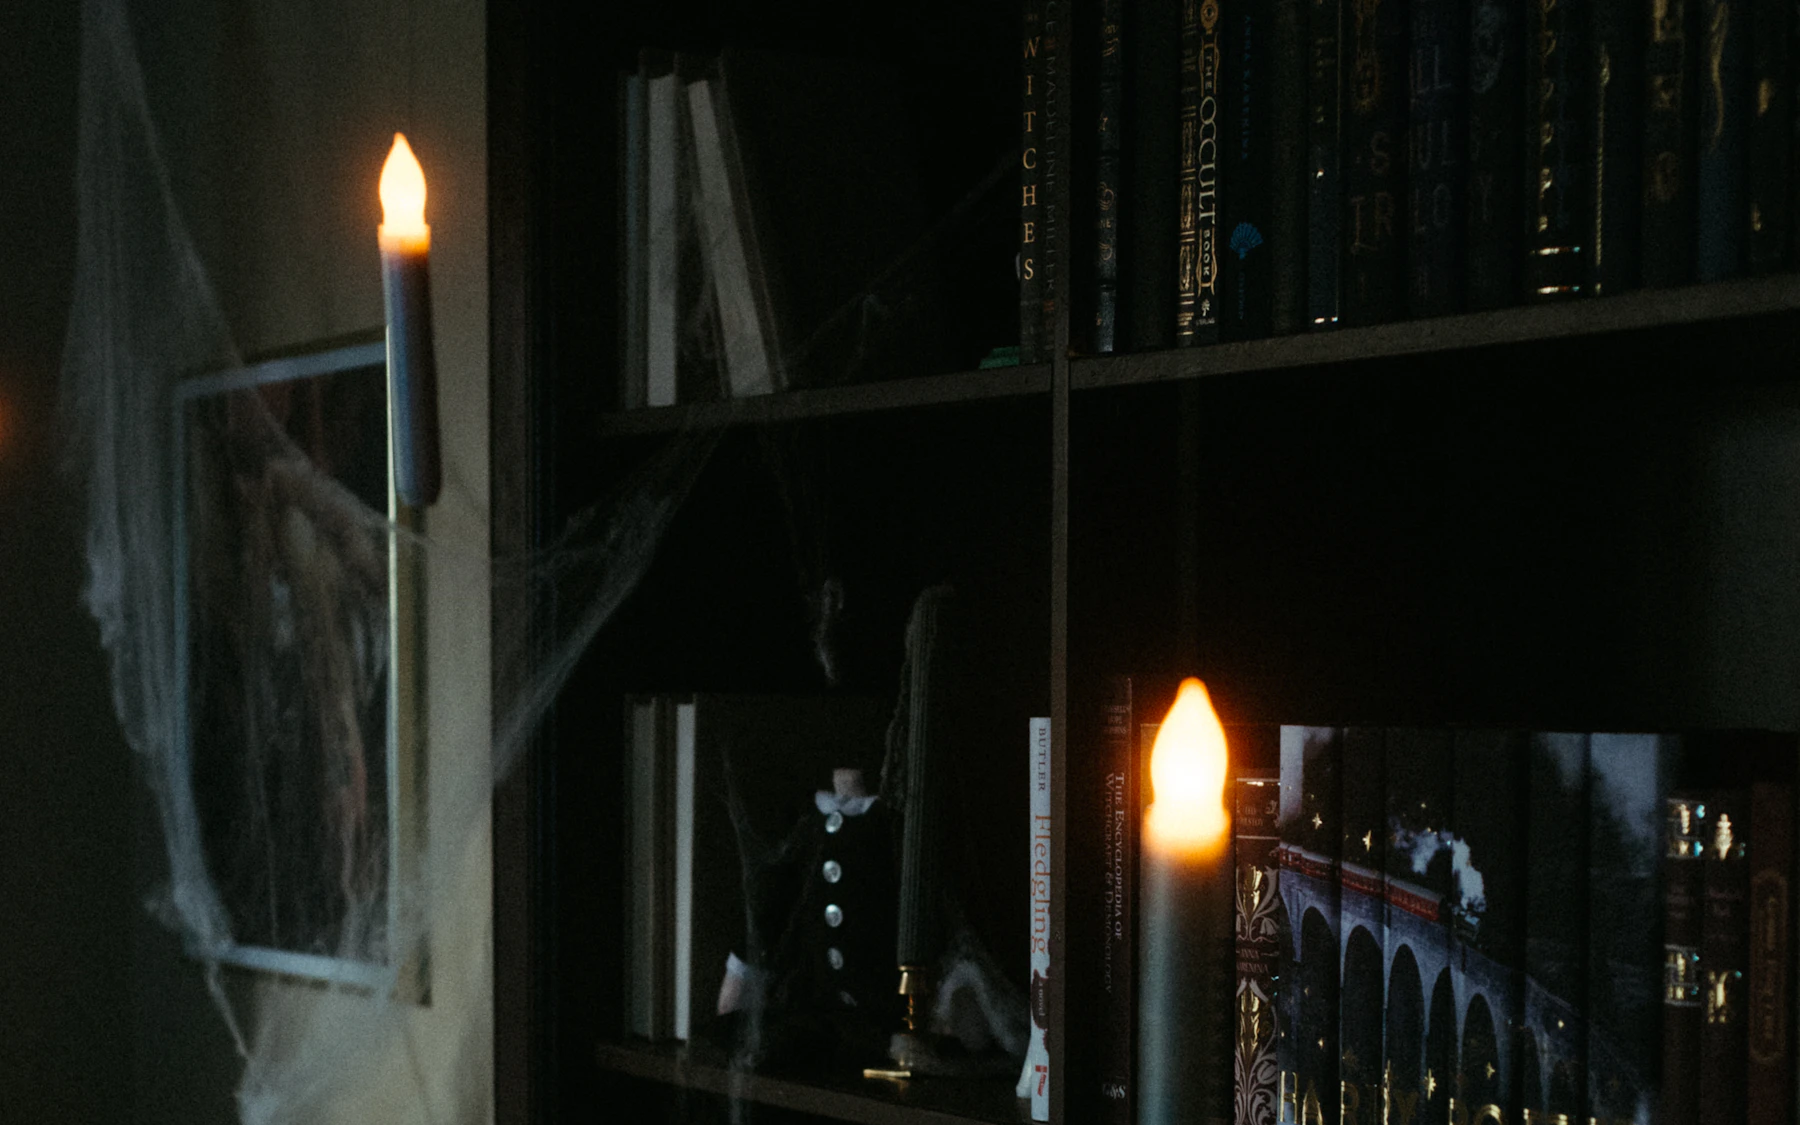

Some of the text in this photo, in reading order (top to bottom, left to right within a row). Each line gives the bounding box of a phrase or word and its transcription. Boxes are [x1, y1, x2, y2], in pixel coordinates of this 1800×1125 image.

[1023, 36, 1041, 281] WITCHES
[1045, 55, 1056, 293] MADELINE MILLER
[1198, 52, 1217, 277] THE OCCULT BOOK
[1037, 727, 1047, 792] BUTLER
[1104, 772, 1115, 869] WITCHCRAFT
[1031, 814, 1051, 955] Fledgling
[1114, 772, 1126, 941] THE ENCYCLOPEDIA OF
[1103, 891, 1115, 994] DEMONOLOGY
